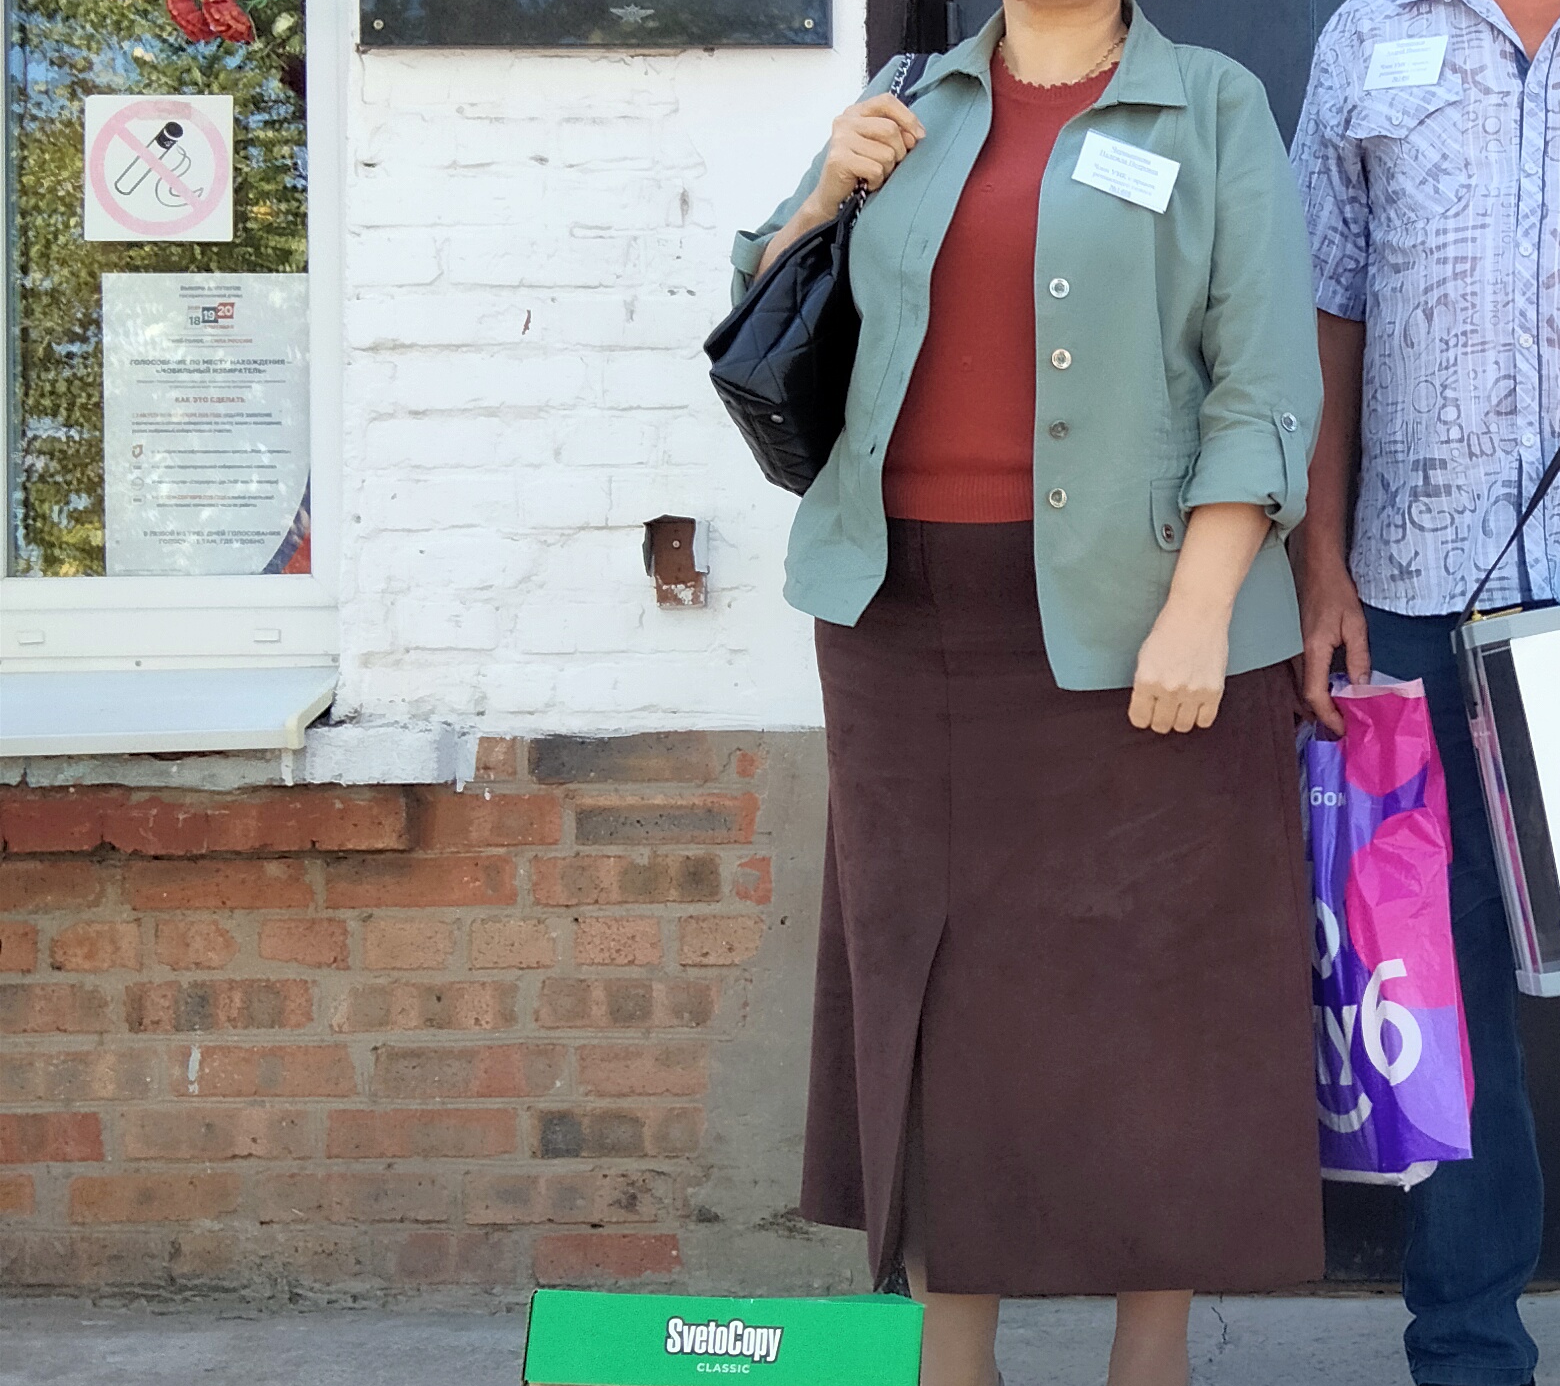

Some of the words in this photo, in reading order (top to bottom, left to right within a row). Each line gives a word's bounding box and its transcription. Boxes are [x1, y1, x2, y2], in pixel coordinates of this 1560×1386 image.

[203, 310, 215, 321] 19
[217, 305, 233, 316] 20
[189, 316, 201, 326] 18
[665, 1315, 784, 1364] SvetoCopy
[696, 1363, 750, 1374] CLASSIC
